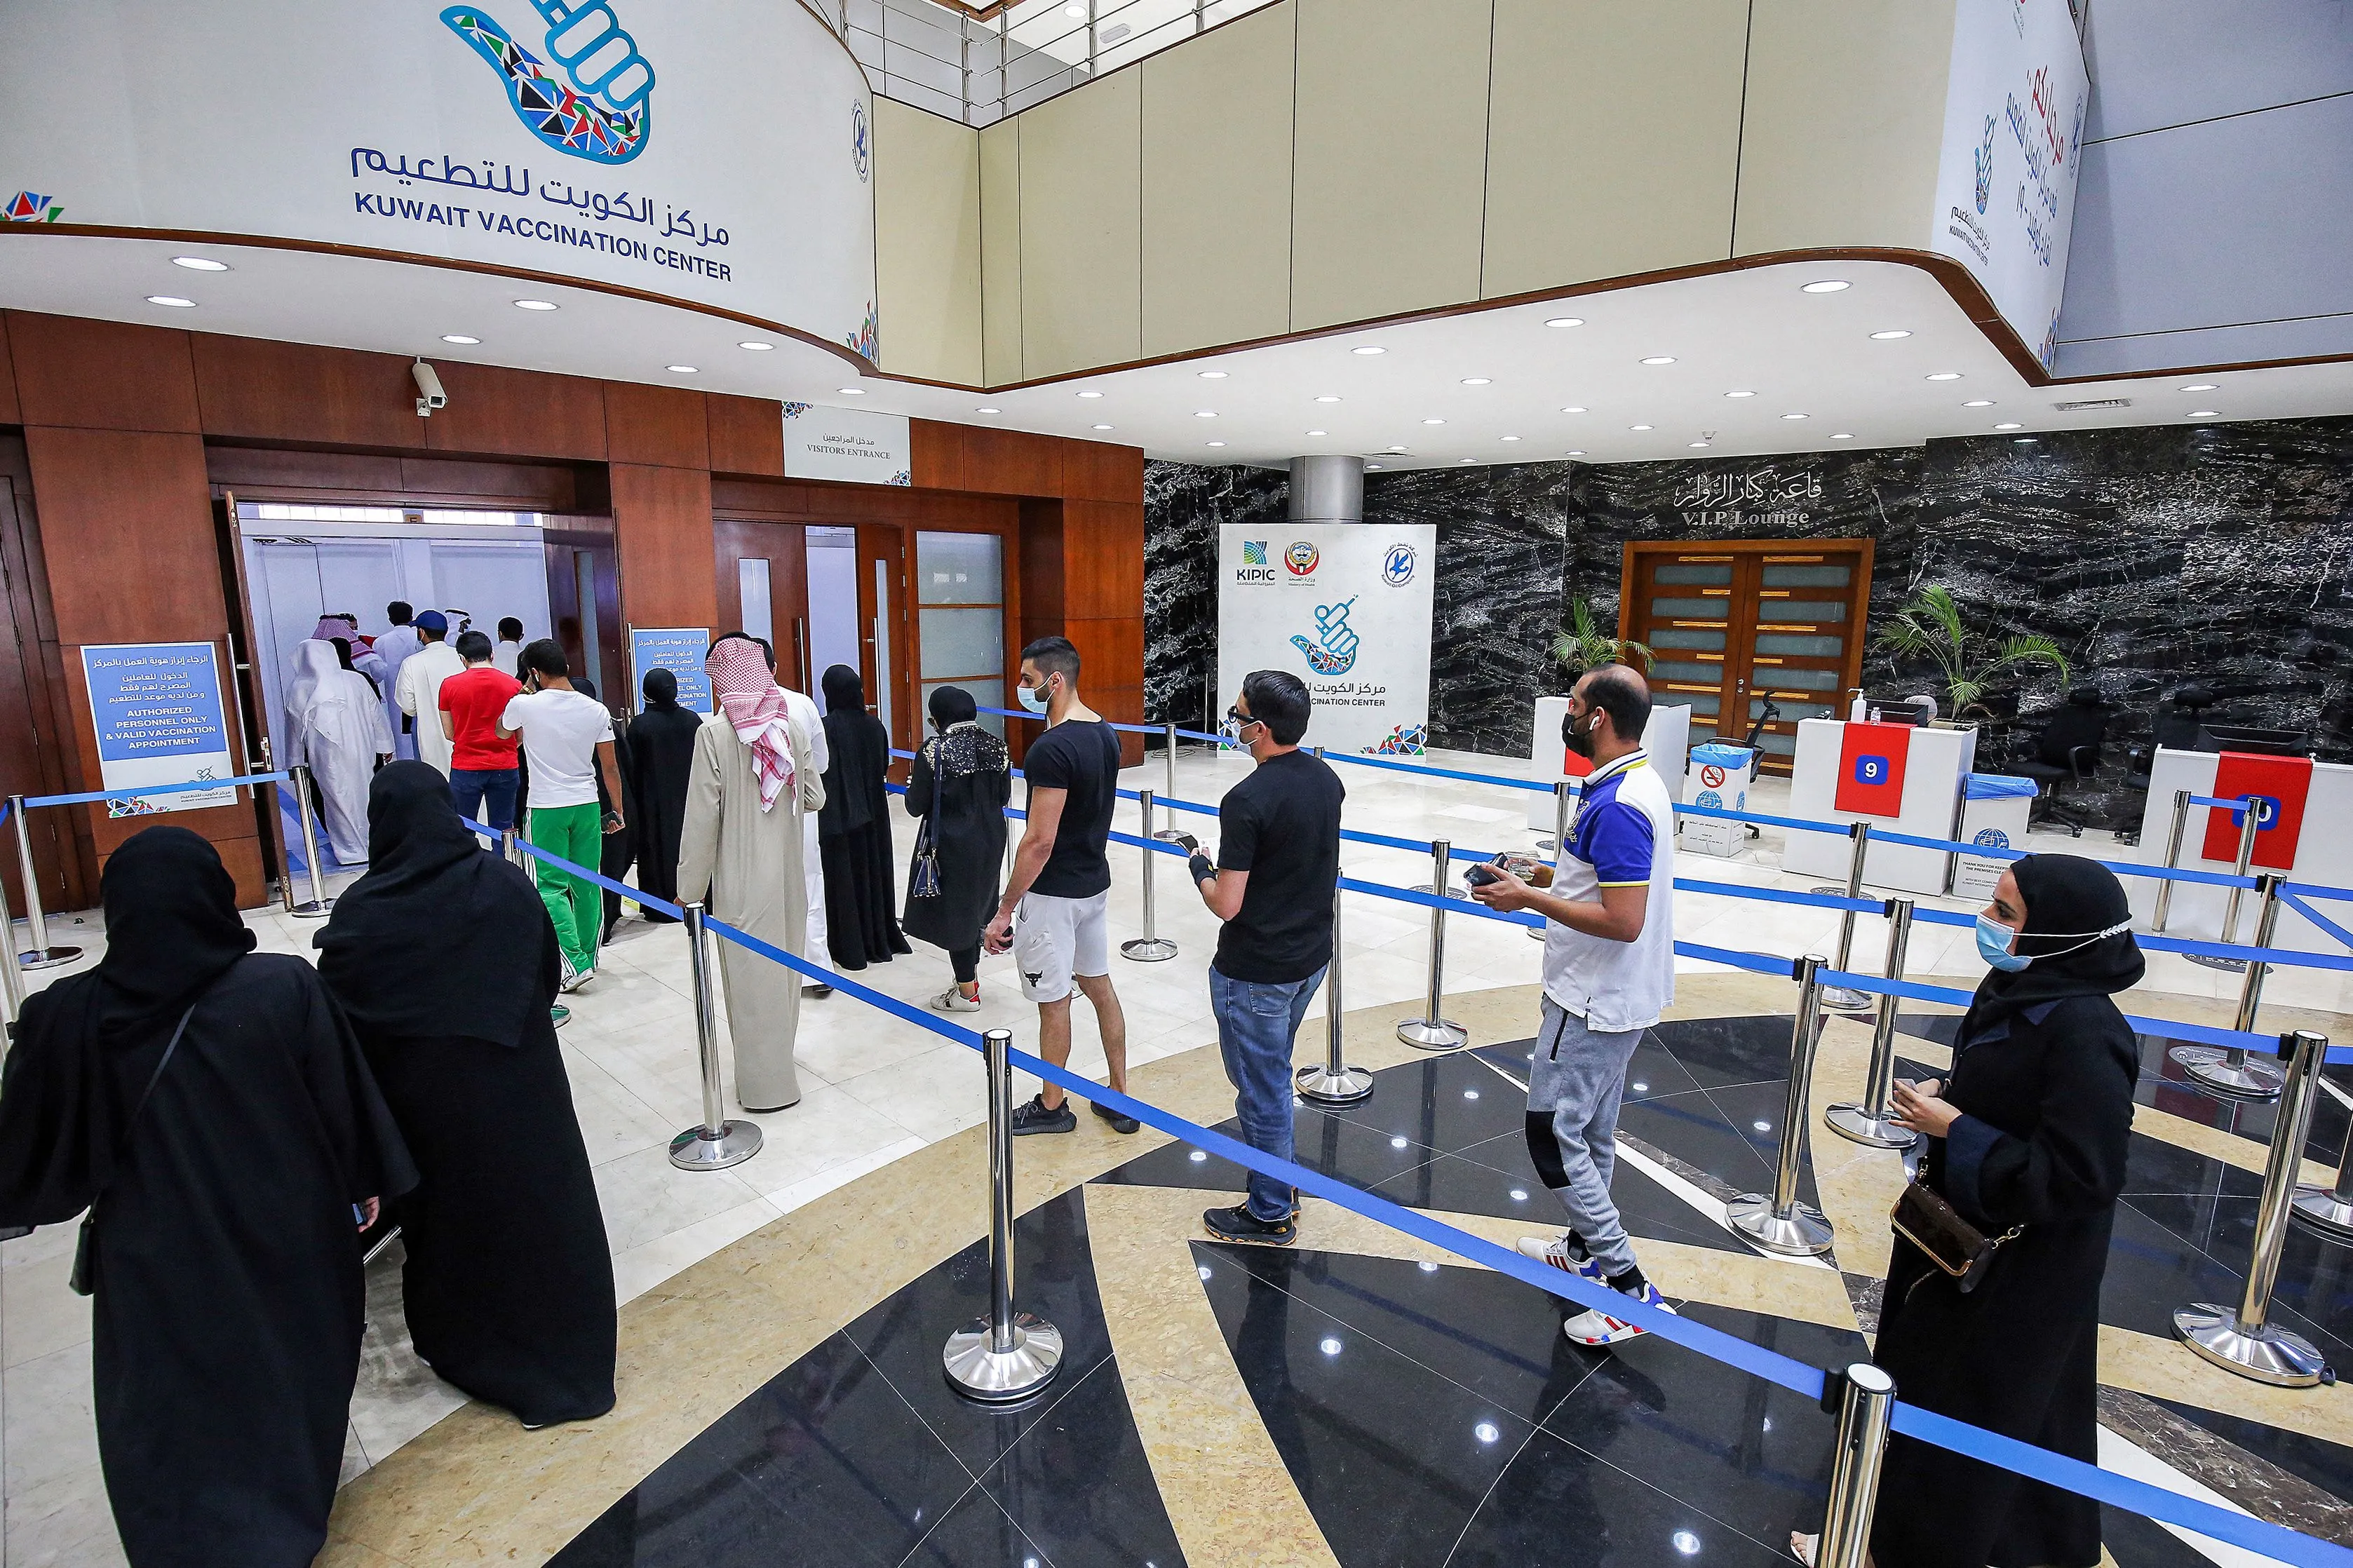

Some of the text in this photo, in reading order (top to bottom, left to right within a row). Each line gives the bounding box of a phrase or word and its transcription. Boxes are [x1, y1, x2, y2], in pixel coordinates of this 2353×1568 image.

[351, 145, 731, 248] مركز الكويت للتطعيم
[353, 191, 732, 283] KUWAIT VACCINATION CENTER
[1948, 224, 1967, 241] KUWAIT
[823, 433, 875, 446] مدخل المراجعين
[807, 444, 891, 459] VISITORS ENTRANCE
[1769, 471, 1822, 503] قاعة
[1681, 510, 1810, 528] V.I.P Lounge
[1236, 569, 1276, 581] KIPIC
[93, 659, 122, 668] بالمركز
[123, 657, 147, 668] العمل
[187, 655, 209, 665] الرجاء
[122, 672, 188, 683] الدخول للعاملين
[120, 682, 191, 693] المصرح لهم فقط
[1314, 682, 1354, 695] الكويت
[1356, 682, 1386, 696] مركز
[109, 694, 142, 704] للتطعيم
[144, 693, 166, 702] موعد
[1351, 698, 1386, 707] CENTER
[126, 705, 193, 717] AUTHORIZED
[116, 715, 208, 729] PERSONNEL ONLY
[115, 730, 147, 740] VALID
[148, 725, 217, 737] VACCINATION
[128, 737, 201, 750] APPOINTMENT
[1863, 762, 1878, 778] 9
